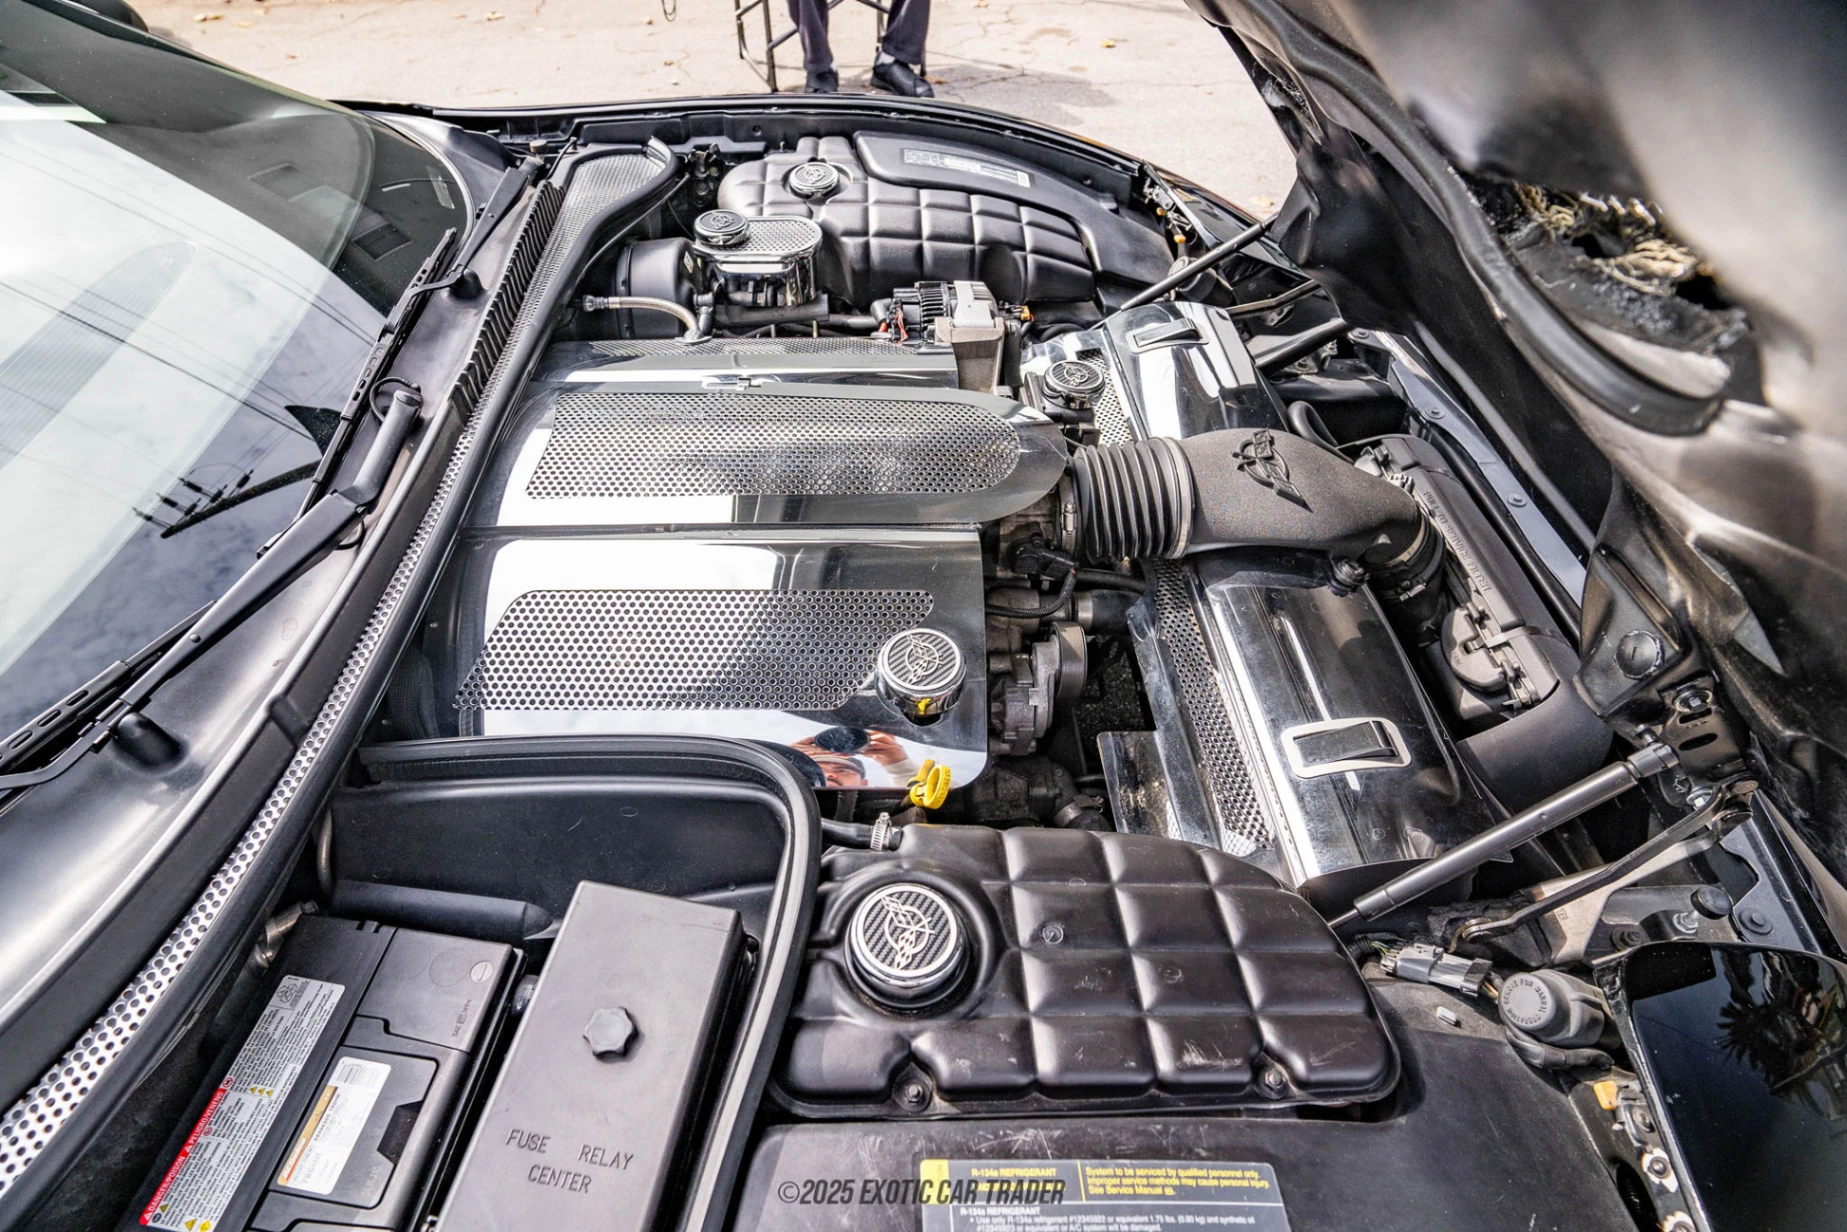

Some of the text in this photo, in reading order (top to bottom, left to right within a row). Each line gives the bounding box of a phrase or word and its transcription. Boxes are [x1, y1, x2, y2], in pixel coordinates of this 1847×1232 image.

[1423, 491, 1439, 510] PULL
[149, 1155, 186, 1212] DANGER/POISON
[188, 1091, 224, 1144] PELIGRO/VENENO
[506, 1129, 634, 1171] FUSE RELAY
[528, 1164, 592, 1193] CENTER
[971, 1167, 1057, 1177] R-134a REFRIGERANT
[1085, 1166, 1260, 1181] System to be serviced by qualified personnel only.
[1087, 1177, 1120, 1187] Improper
[1121, 1177, 1148, 1185] service
[1148, 1177, 1180, 1186] methods
[1180, 1178, 1196, 1188] may
[1220, 1179, 1249, 1188] personal
[1250, 1180, 1270, 1190] injury.
[1088, 1185, 1104, 1195] See
[1105, 1185, 1134, 1195] Service
[1134, 1185, 1163, 1195] Manual
[960, 1207, 1040, 1216] R-134a REFRIGERANT
[976, 1216, 990, 1224] Use
[991, 1216, 1006, 1225] only
[1033, 1216, 1068, 1225] refrigerant
[1115, 1215, 1149, 1224] equivalent
[1206, 1215, 1219, 1224] and
[1219, 1216, 1247, 1225] synthetic
